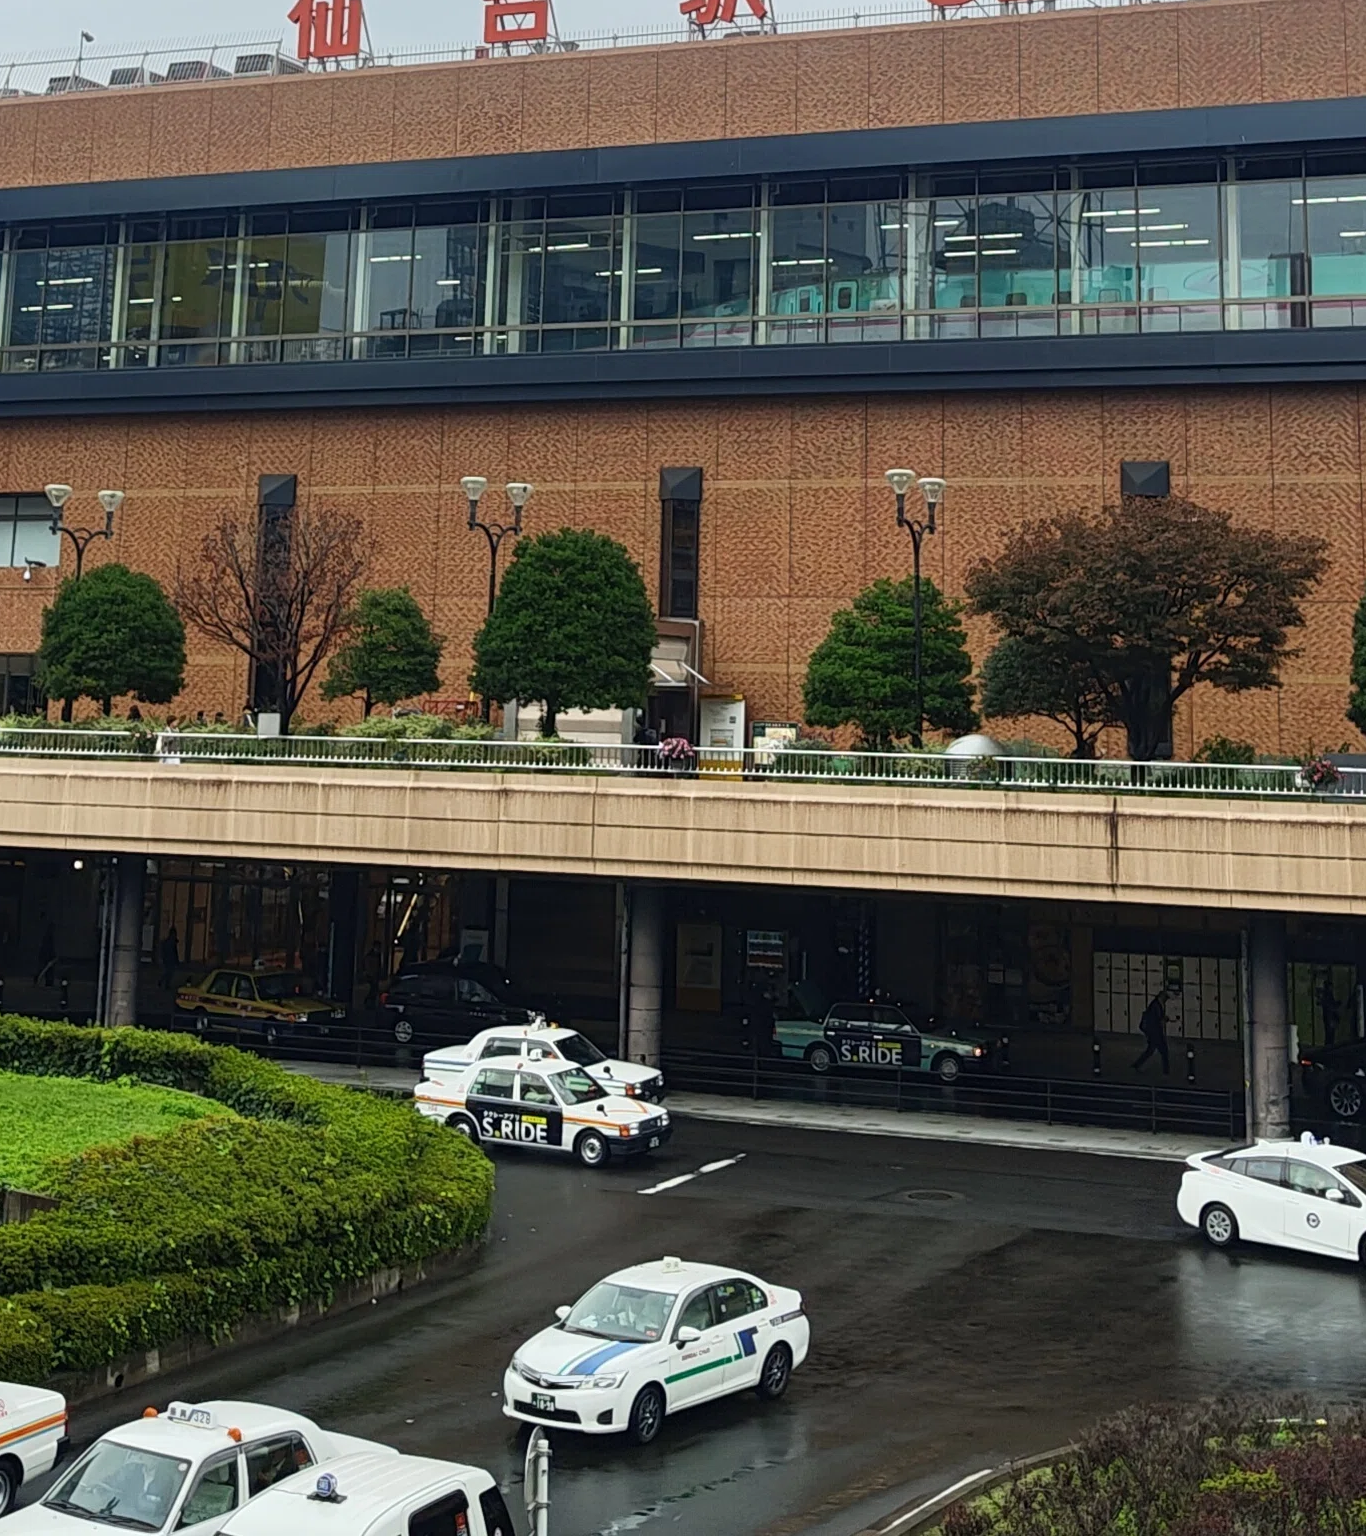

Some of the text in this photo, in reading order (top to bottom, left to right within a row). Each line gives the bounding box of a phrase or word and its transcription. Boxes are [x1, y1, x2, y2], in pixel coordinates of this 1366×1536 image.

[840, 1044, 903, 1065] S.RIDE
[482, 1117, 548, 1145] S.RIDE
[194, 1412, 211, 1425] 328
